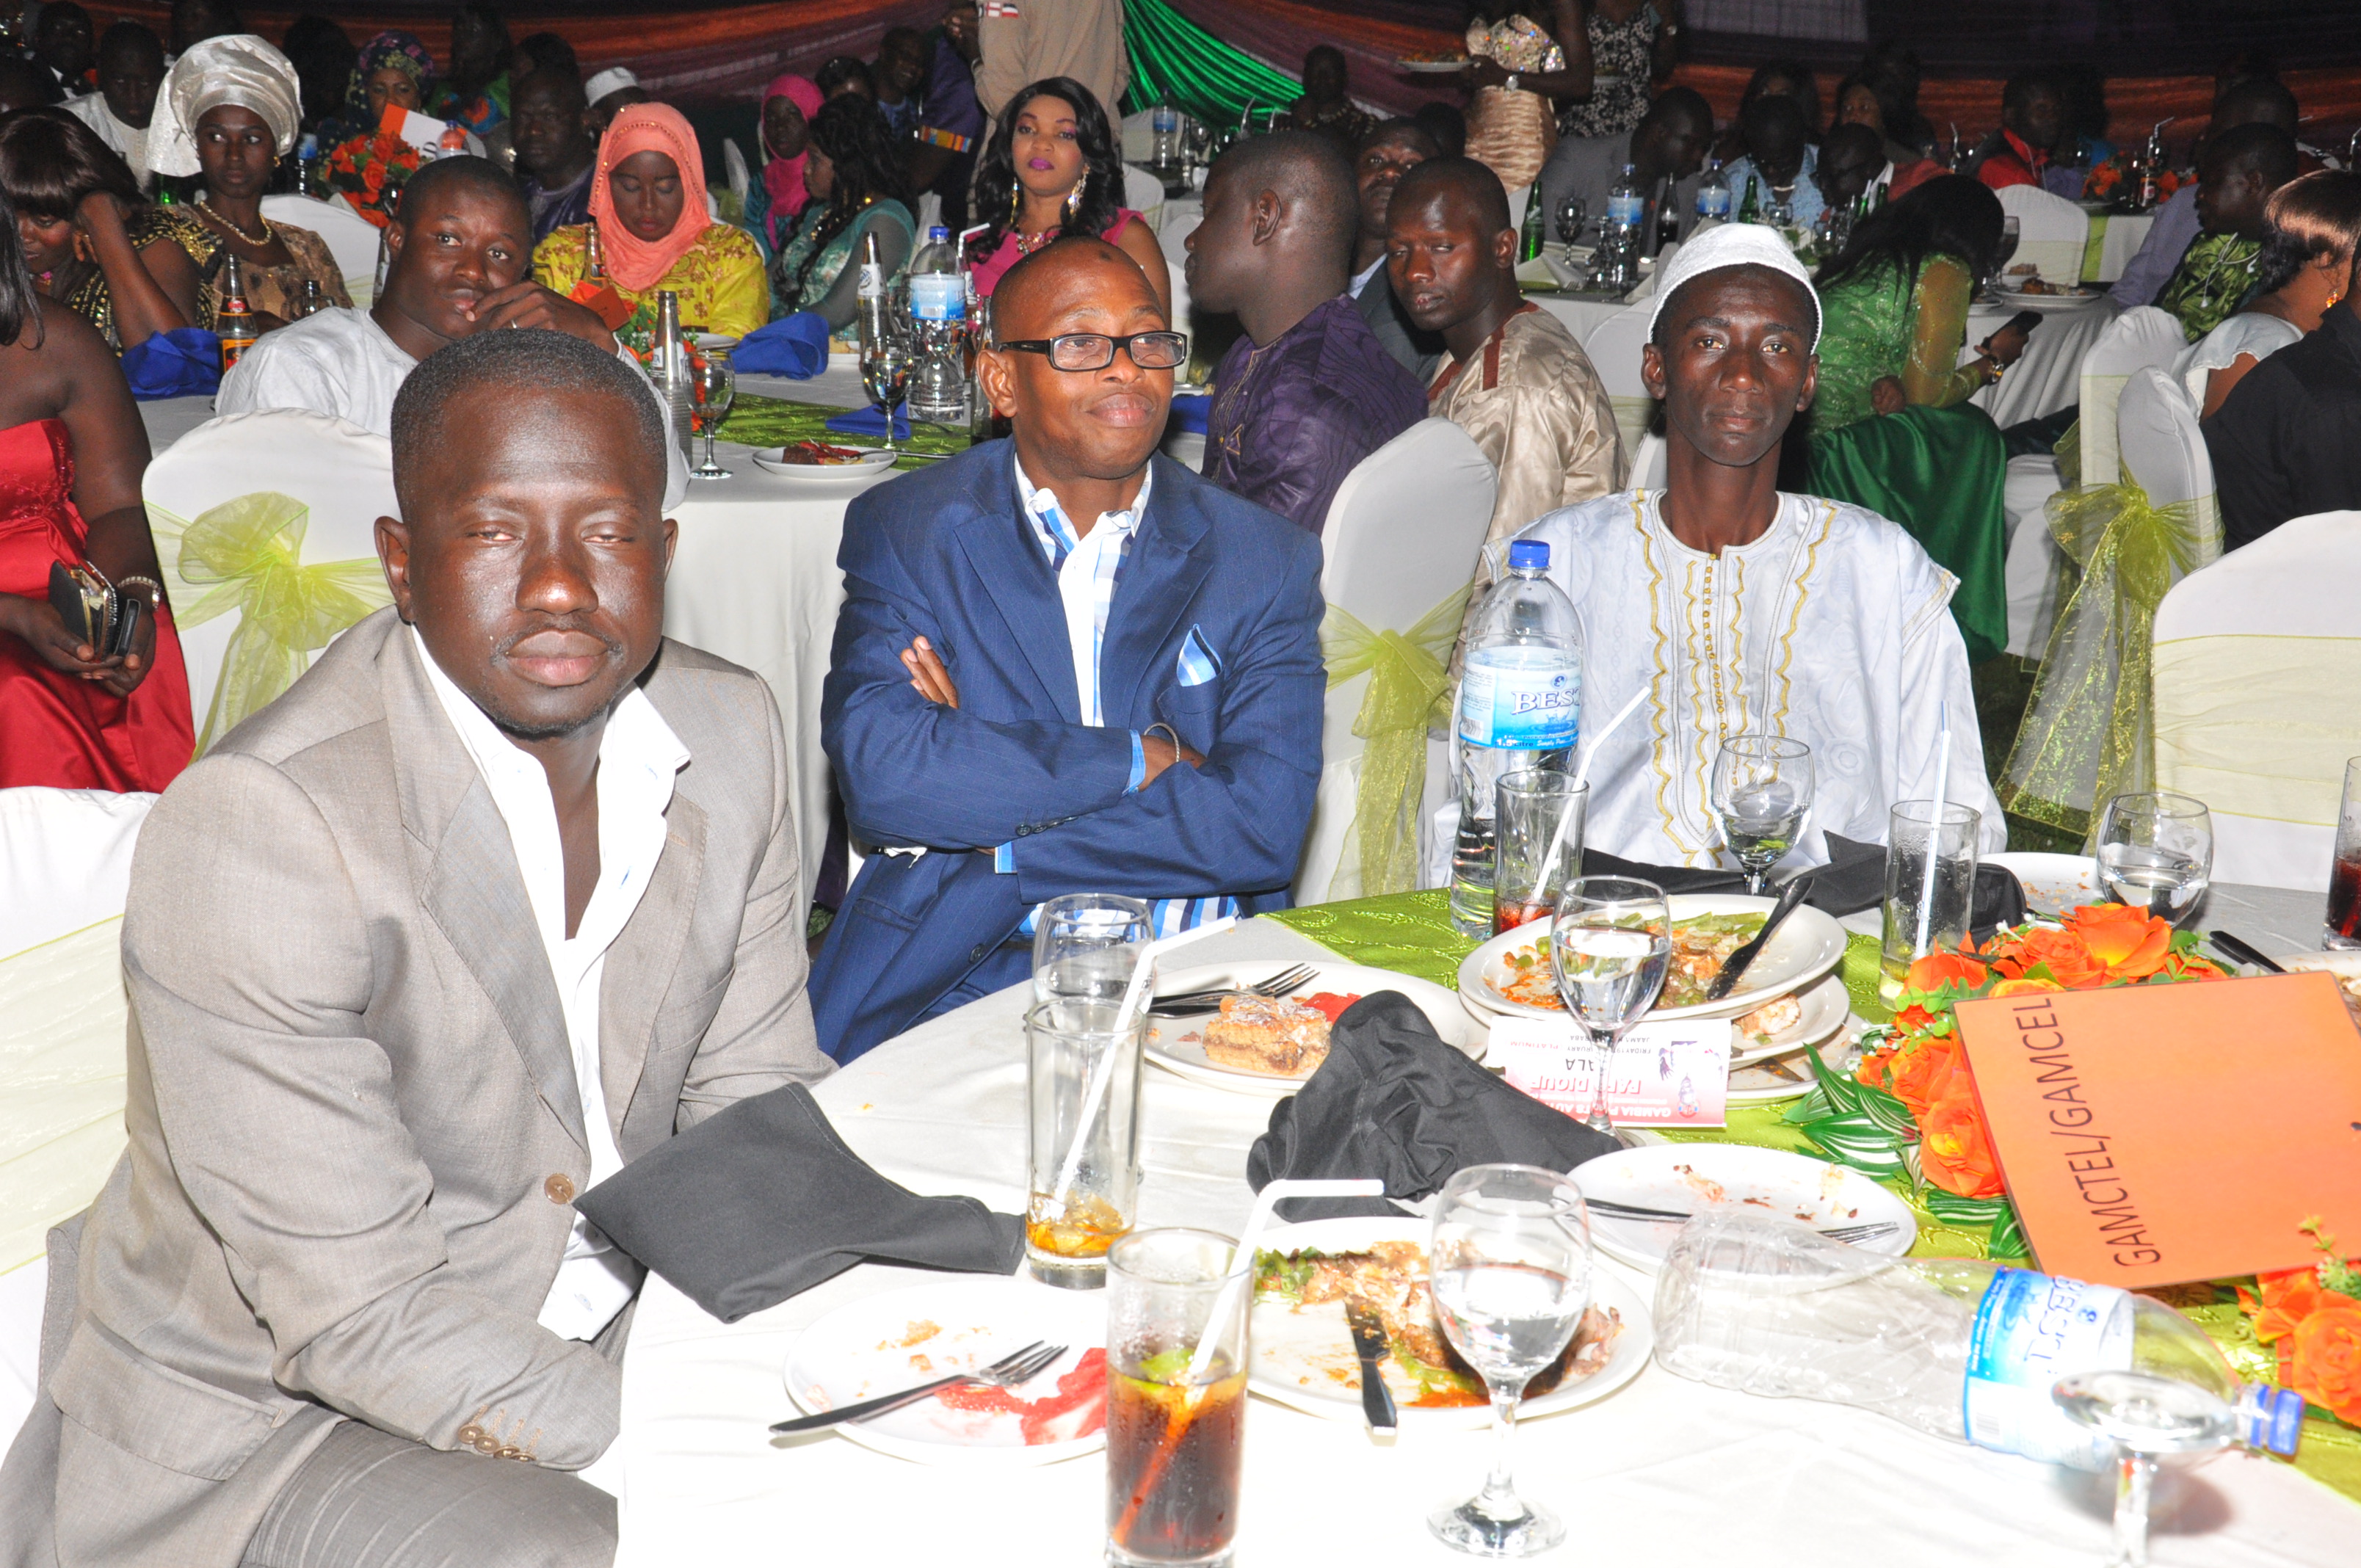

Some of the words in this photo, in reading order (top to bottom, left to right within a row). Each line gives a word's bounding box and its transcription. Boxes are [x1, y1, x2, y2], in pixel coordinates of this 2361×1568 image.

[1510, 1040, 1559, 1049] PLATINUM
[1621, 1106, 1672, 1117] GAMBIA
[2012, 998, 2161, 1267] GAMCTEL/GAMCEL
